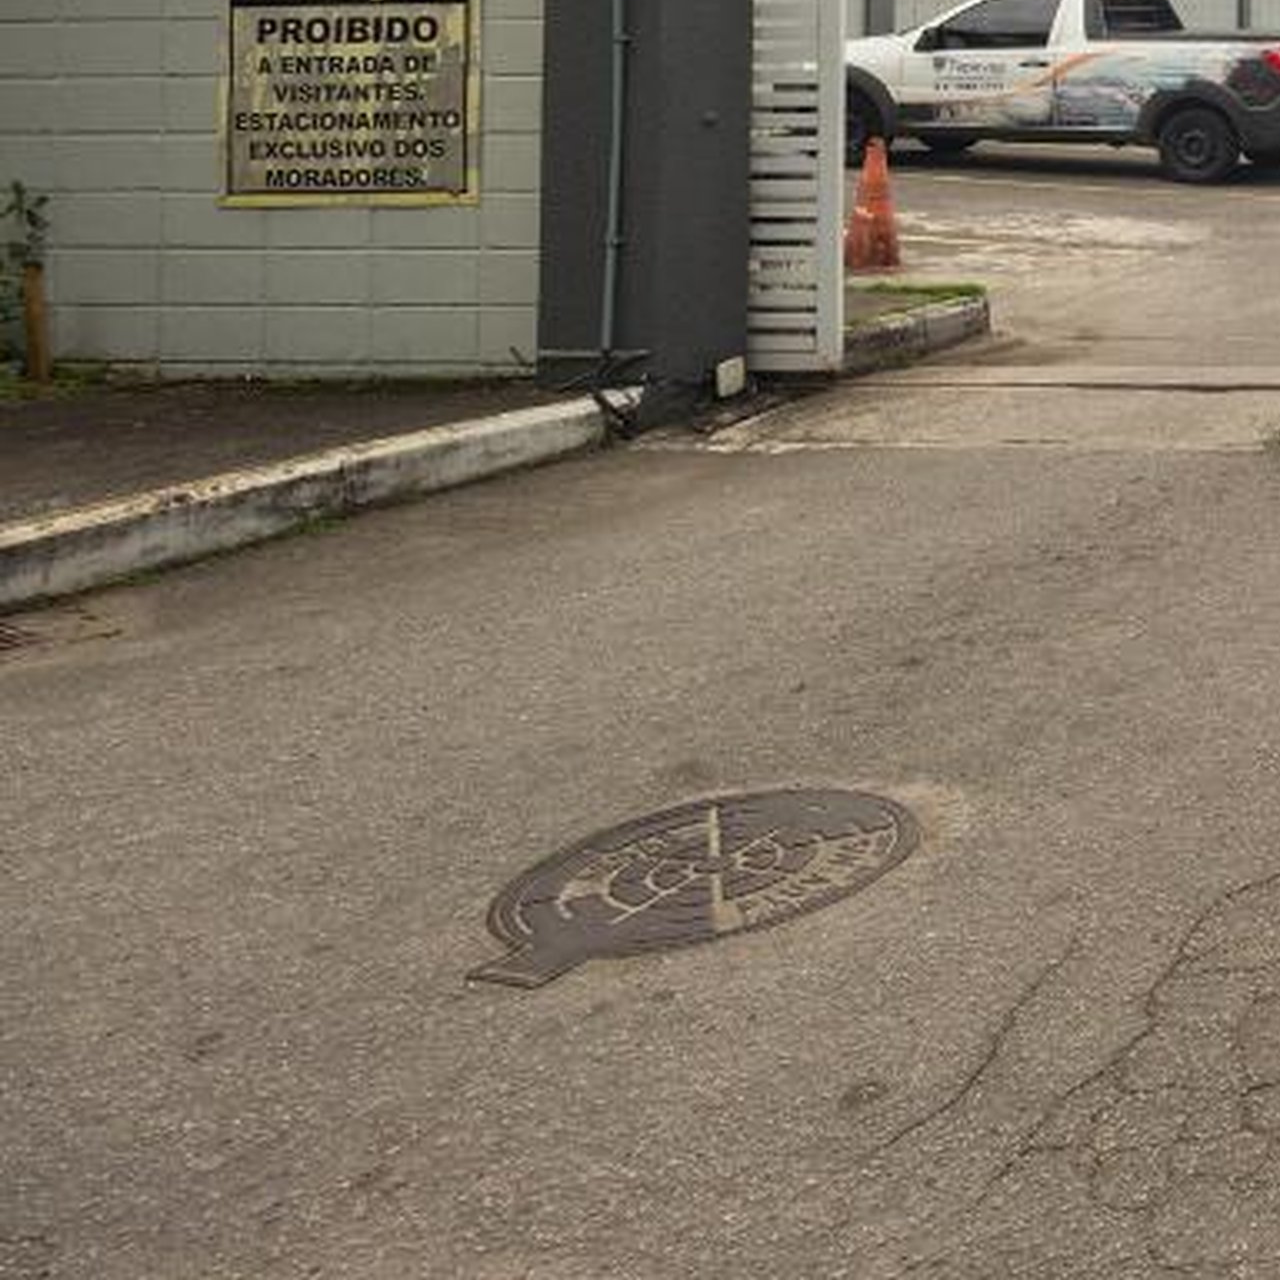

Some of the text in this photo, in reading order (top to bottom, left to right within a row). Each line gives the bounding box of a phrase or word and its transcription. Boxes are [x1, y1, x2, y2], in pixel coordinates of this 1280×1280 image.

[257, 17, 438, 44] PROIBIDO
[258, 55, 435, 74] A ENTRADA DE
[235, 111, 460, 131] ESTACIONAMENTO
[249, 139, 446, 160] EXCLUSIVO DOS
